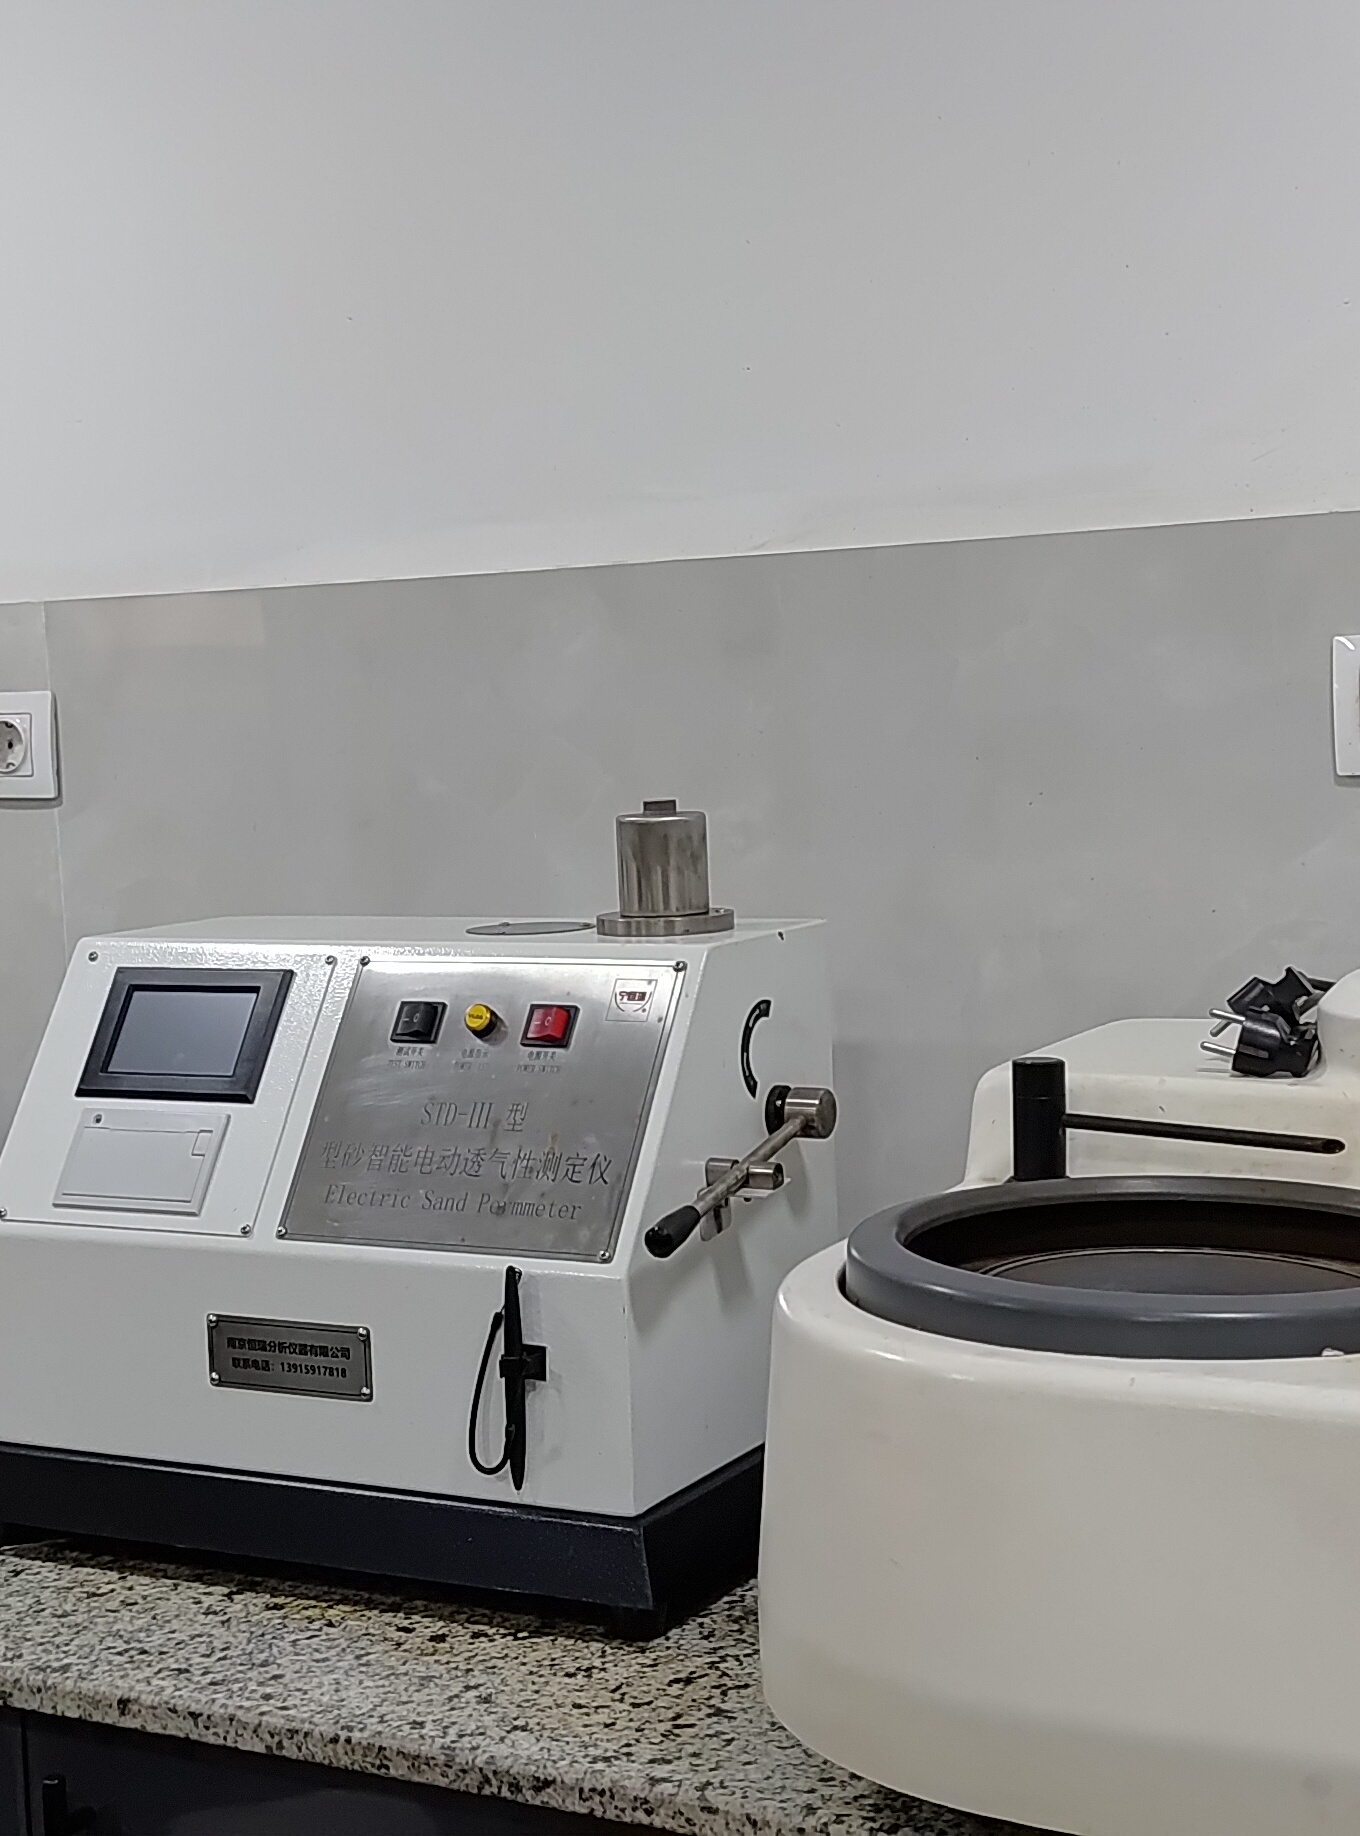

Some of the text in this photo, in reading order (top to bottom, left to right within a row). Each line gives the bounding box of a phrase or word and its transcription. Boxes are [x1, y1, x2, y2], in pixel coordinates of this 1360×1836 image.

[503, 1102, 529, 1133] 型
[321, 1140, 612, 1186] 型砂智能电动透气性测定仪
[324, 1184, 411, 1209] Electric
[422, 1190, 470, 1214] Sand
[226, 1337, 351, 1360] 南京恒瑞分析仪器有限公司
